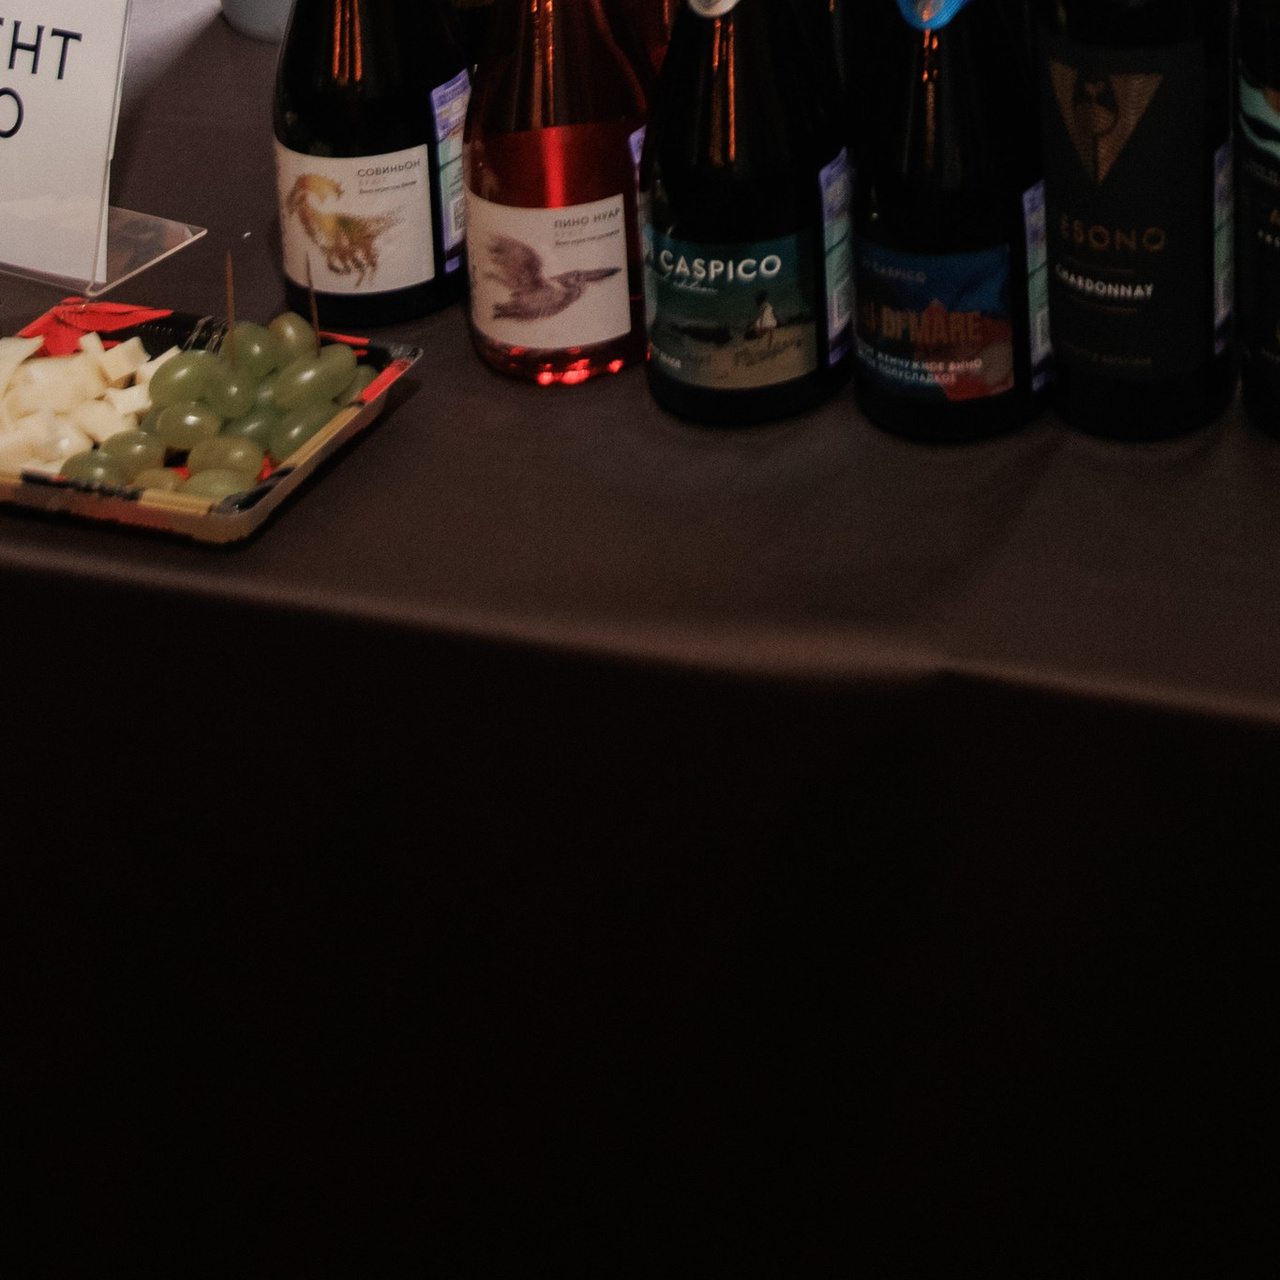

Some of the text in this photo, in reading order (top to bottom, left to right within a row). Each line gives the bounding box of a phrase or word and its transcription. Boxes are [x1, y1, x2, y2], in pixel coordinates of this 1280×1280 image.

[356, 158, 421, 178] СОВИНЬОН
[554, 207, 621, 229] ПИНО НУАР
[660, 249, 782, 281] CASPICO
[1055, 262, 1154, 300] CHARDONNAY
[947, 357, 983, 372] ВИНО
